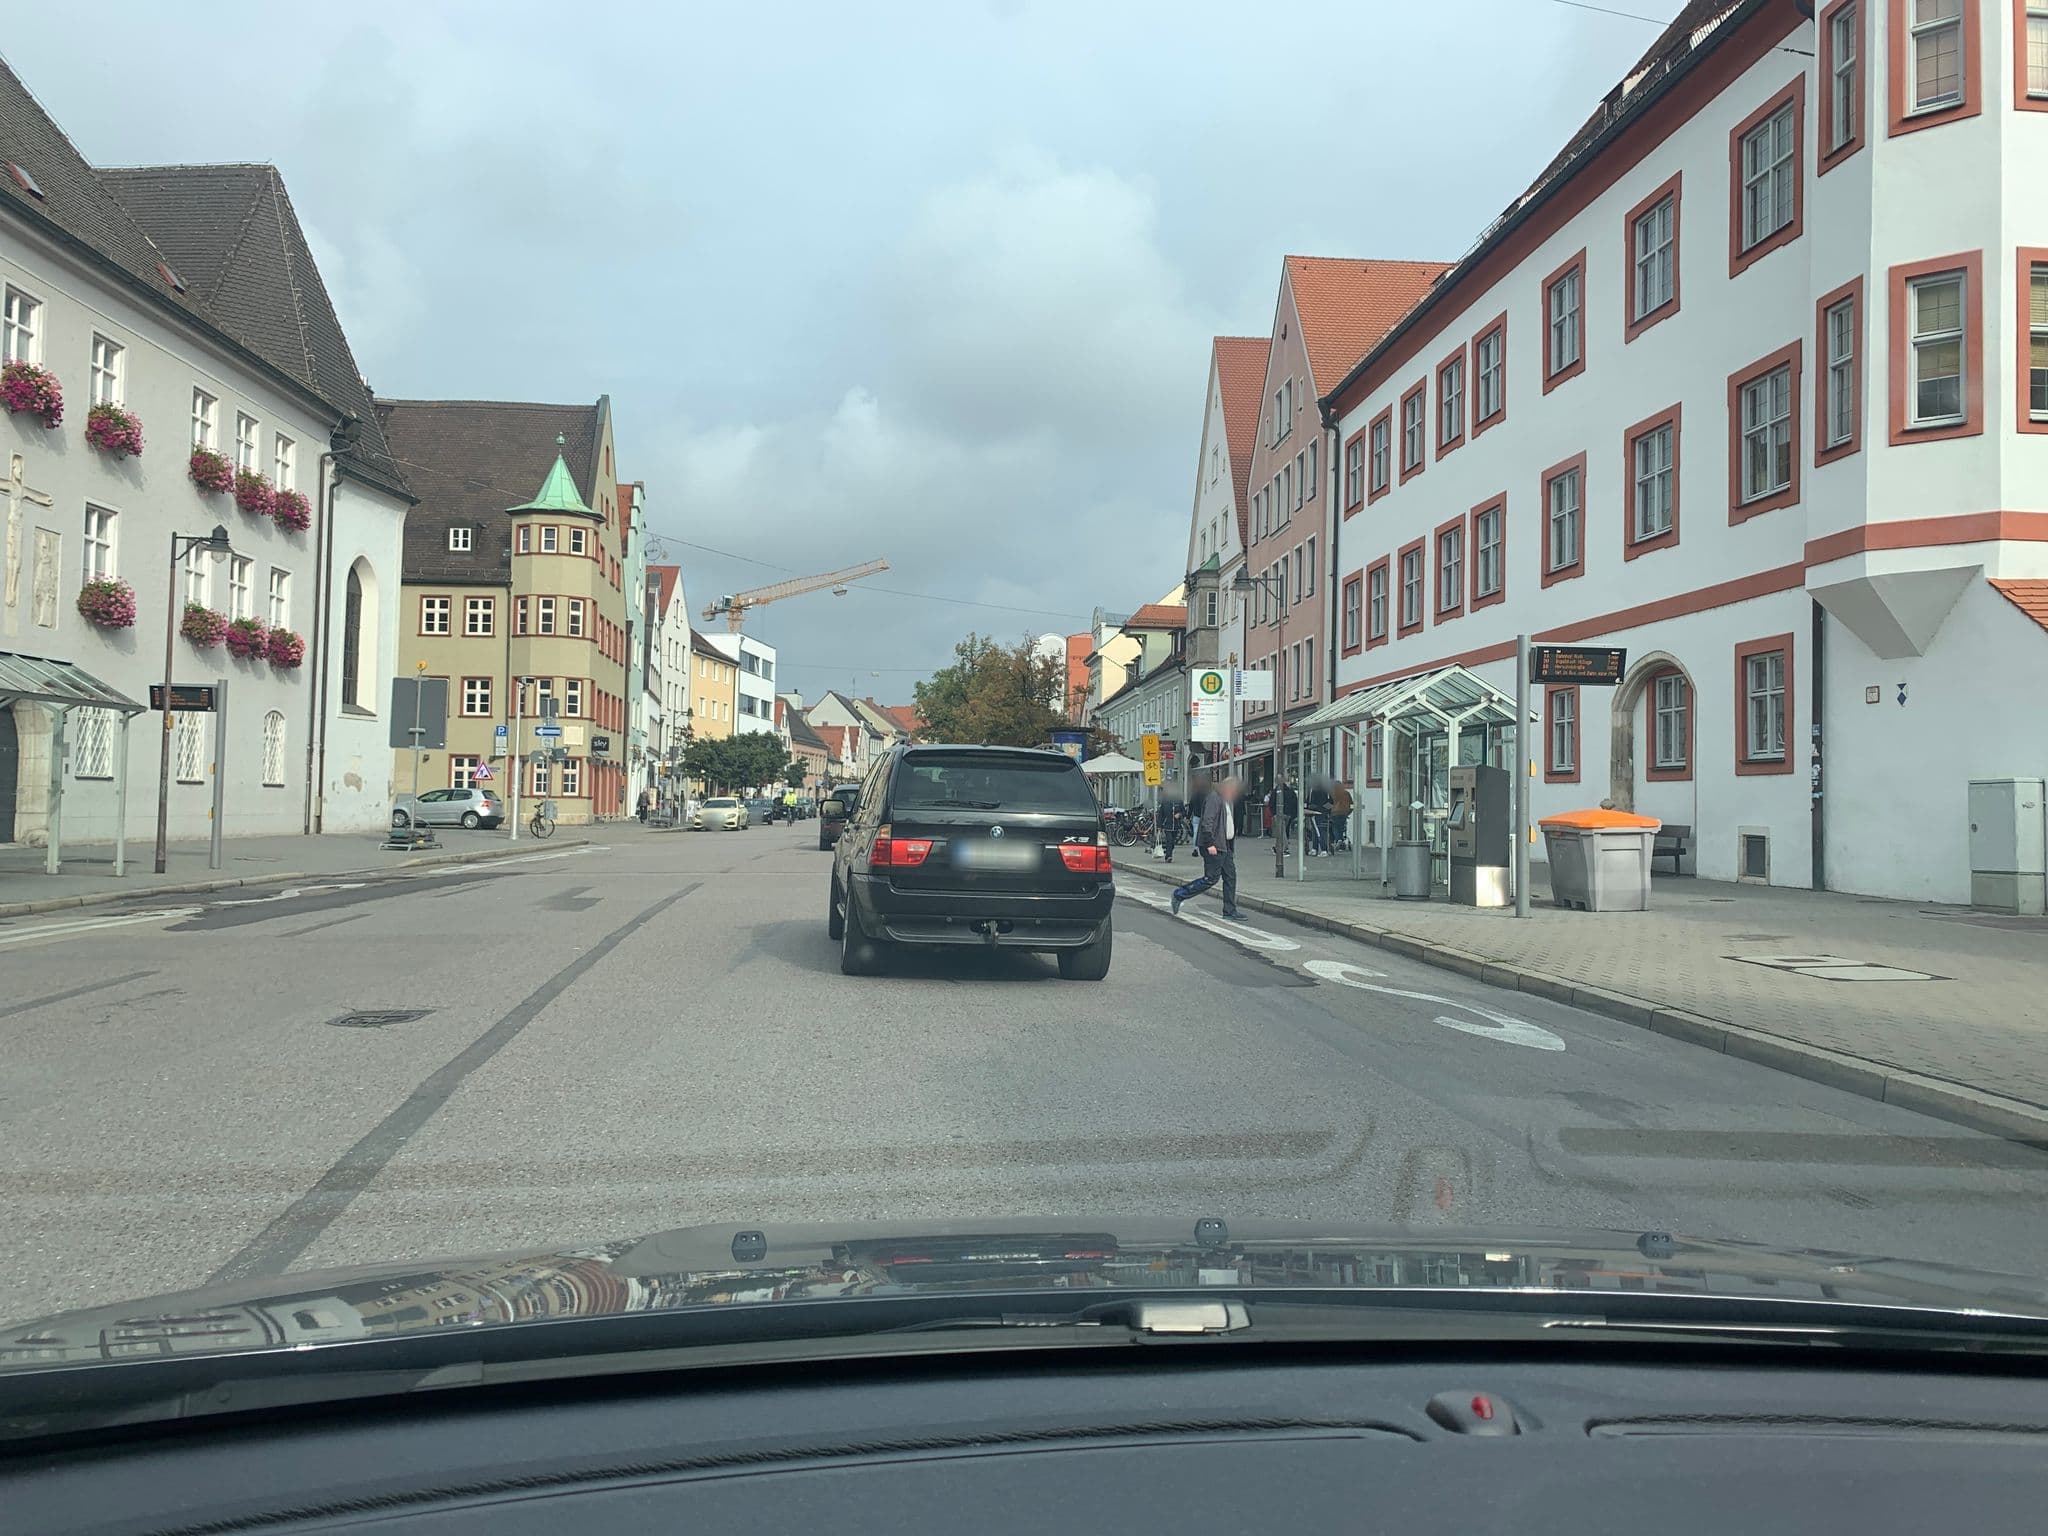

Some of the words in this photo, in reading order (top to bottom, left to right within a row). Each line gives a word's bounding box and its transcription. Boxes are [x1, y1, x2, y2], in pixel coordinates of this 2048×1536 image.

[1206, 676, 1216, 690] H
[498, 726, 506, 735] P
[594, 740, 608, 749] sky
